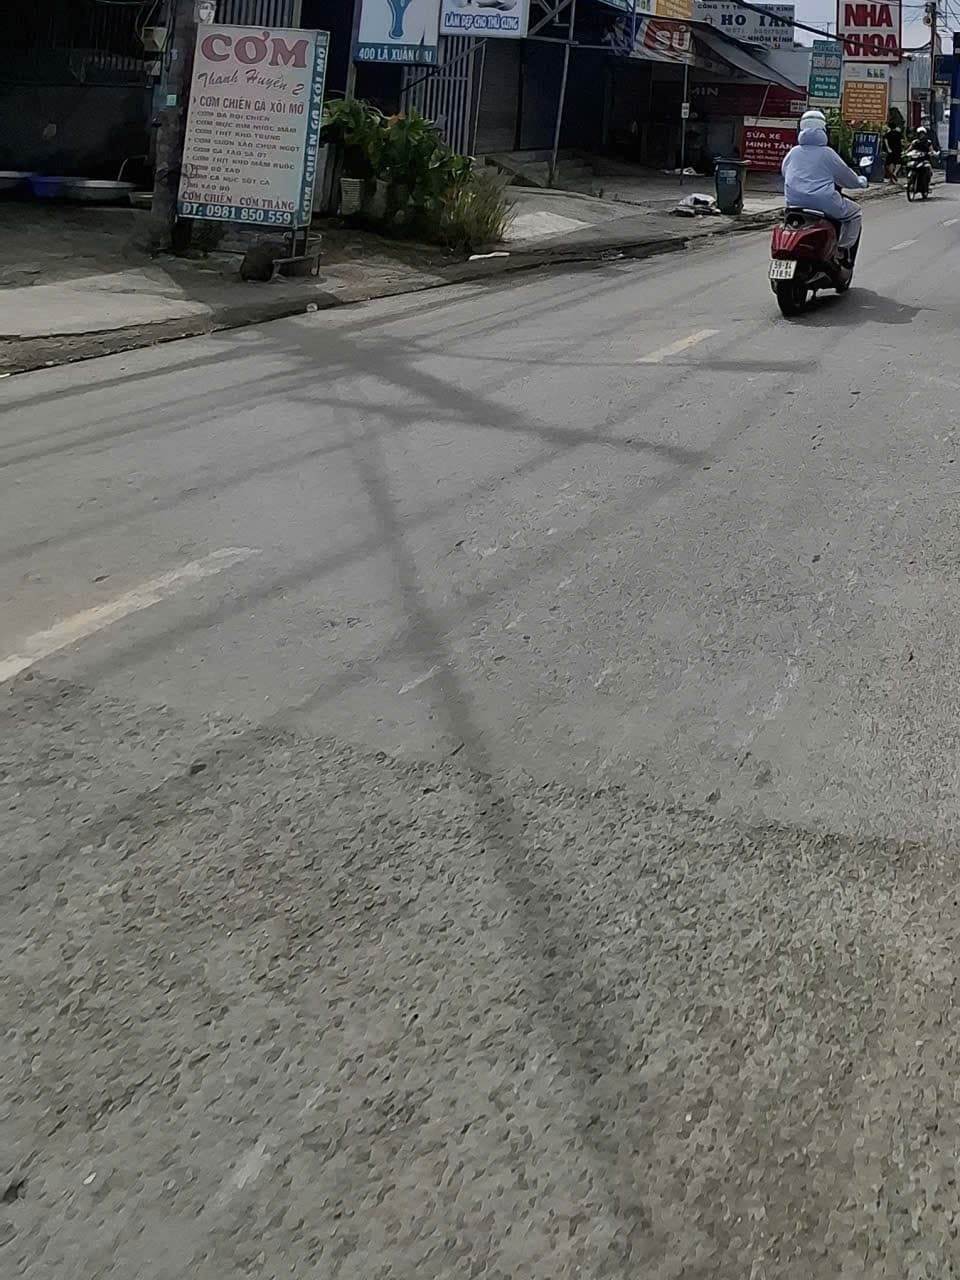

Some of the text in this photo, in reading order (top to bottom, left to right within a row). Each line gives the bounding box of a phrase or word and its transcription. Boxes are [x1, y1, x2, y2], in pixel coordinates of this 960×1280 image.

[474, 15, 488, 29] CHO
[844, 3, 893, 28] NHA
[201, 31, 310, 68] CƠM
[840, 33, 899, 57] KHOA
[358, 47, 375, 61] 400
[391, 46, 414, 62] XUÂN
[197, 70, 238, 88] Thanh
[292, 83, 304, 96] 2
[200, 95, 220, 107] CƠM
[745, 129, 781, 141] SỬA XE
[745, 141, 771, 150] MINH
[182, 190, 201, 202] CƠM
[182, 202, 292, 224] ĐT: 0981 850 559
